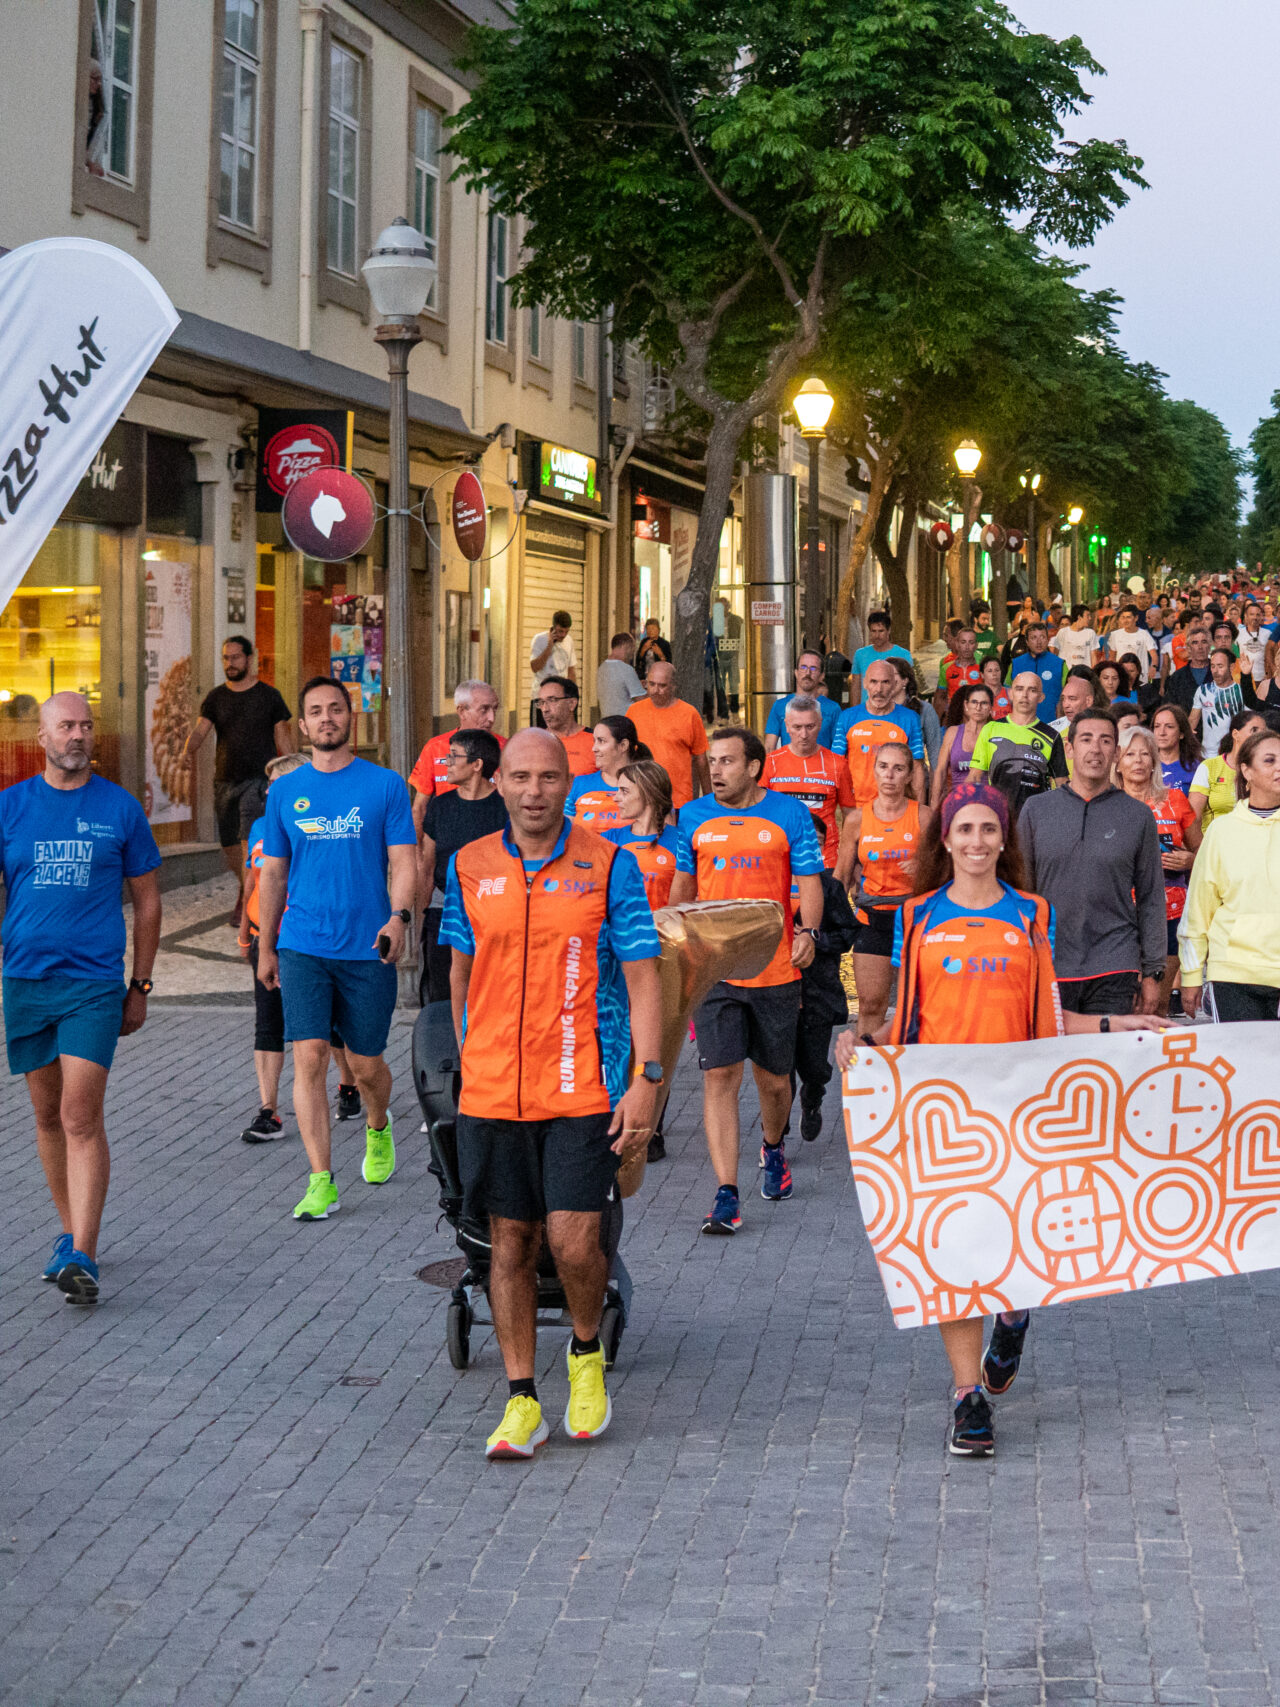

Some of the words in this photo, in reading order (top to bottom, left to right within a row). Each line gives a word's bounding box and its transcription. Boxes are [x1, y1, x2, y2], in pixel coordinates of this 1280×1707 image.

[0, 422, 50, 526] zza
[39, 316, 106, 424] Hut
[277, 453, 322, 475] Pizza
[753, 602, 782, 610] COMPRO
[803, 777, 836, 787] ESPINHO
[315, 806, 364, 834] Sub4
[598, 811, 618, 821] SN
[34, 840, 94, 863] FAMILY
[729, 855, 763, 870] SNT
[882, 849, 910, 860] SNT
[32, 863, 72, 886] RACE
[476, 876, 508, 901] RE
[562, 879, 597, 894] SNT
[563, 935, 583, 1011] ESPINHO
[966, 956, 1012, 973] SNT
[559, 1014, 577, 1094] RUNNING
